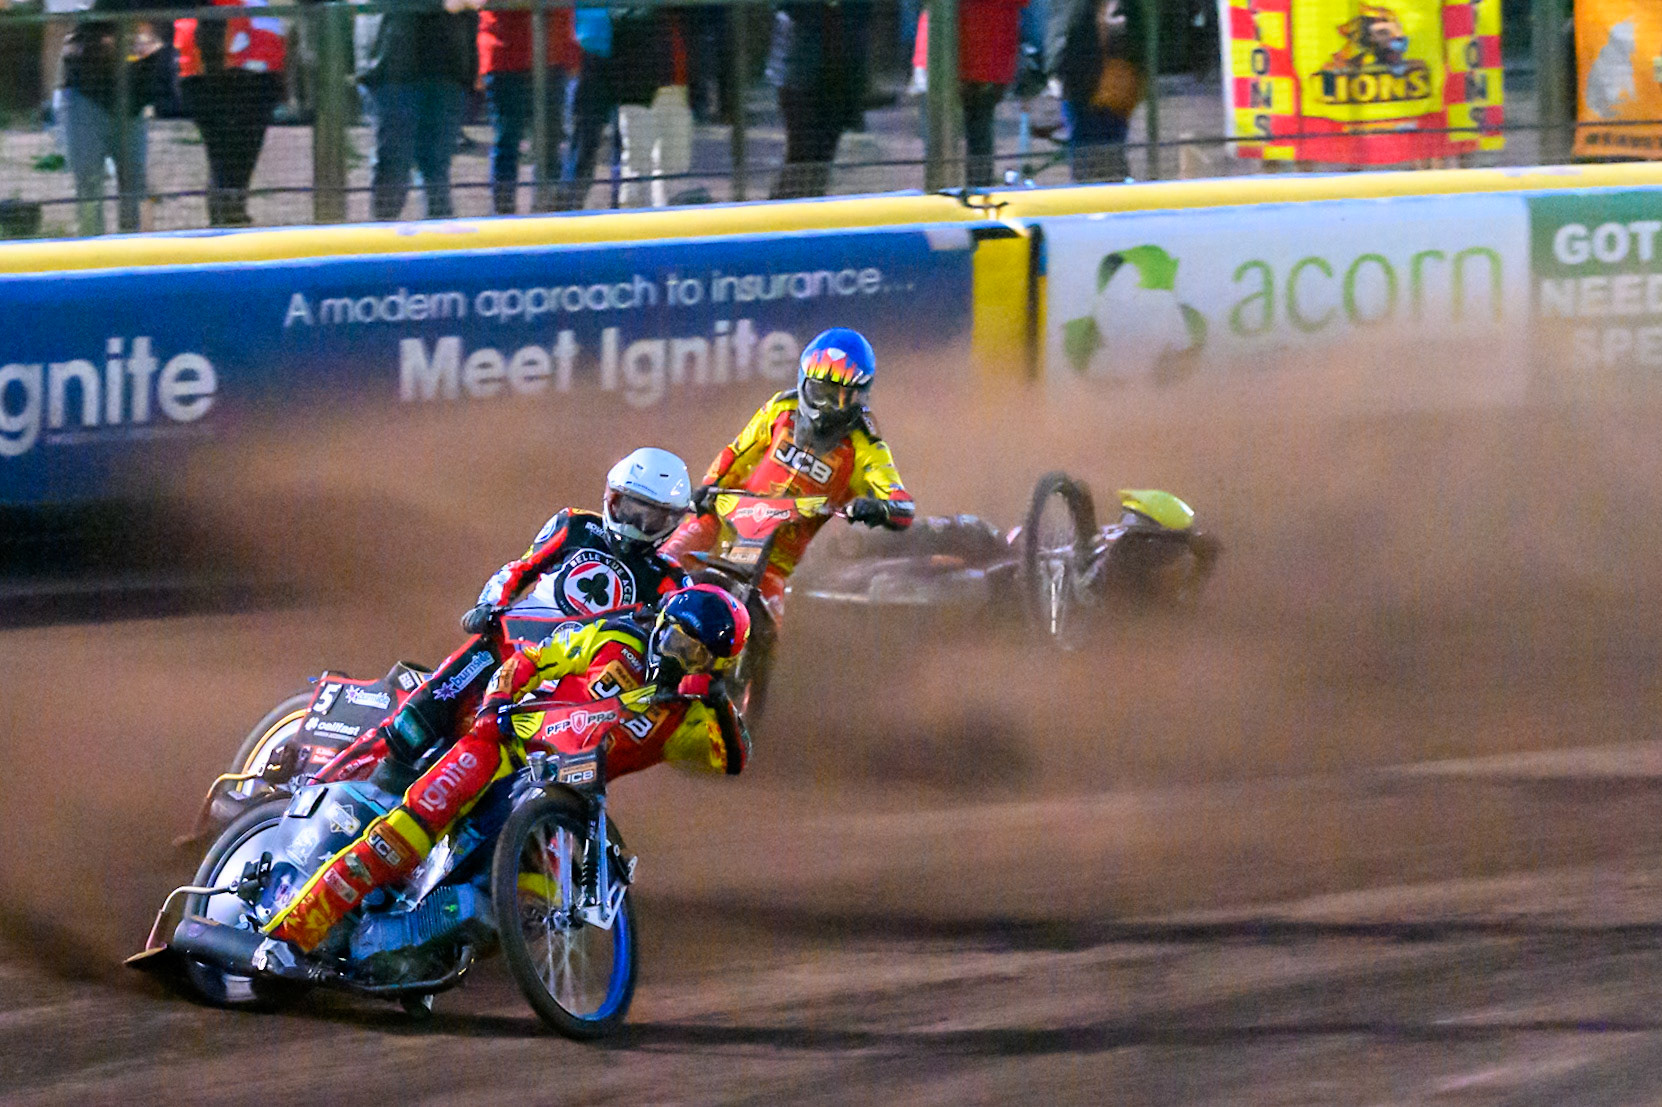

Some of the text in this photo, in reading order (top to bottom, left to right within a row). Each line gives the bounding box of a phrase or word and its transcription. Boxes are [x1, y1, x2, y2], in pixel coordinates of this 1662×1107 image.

[1314, 68, 1430, 103] LIONS
[1553, 221, 1662, 264] GOT
[284, 294, 313, 328] A
[320, 288, 466, 325] modern
[476, 275, 658, 323] approach
[667, 277, 701, 305] to
[1229, 246, 1502, 337] acorn
[401, 318, 798, 407] Meet Ignite
[0, 335, 217, 456] gnite
[775, 446, 833, 484] JCB
[606, 558, 625, 576] VUE
[452, 651, 491, 687] burnside
[312, 683, 343, 712] 5
[547, 720, 571, 735] PFP
[561, 770, 594, 783] JCB
